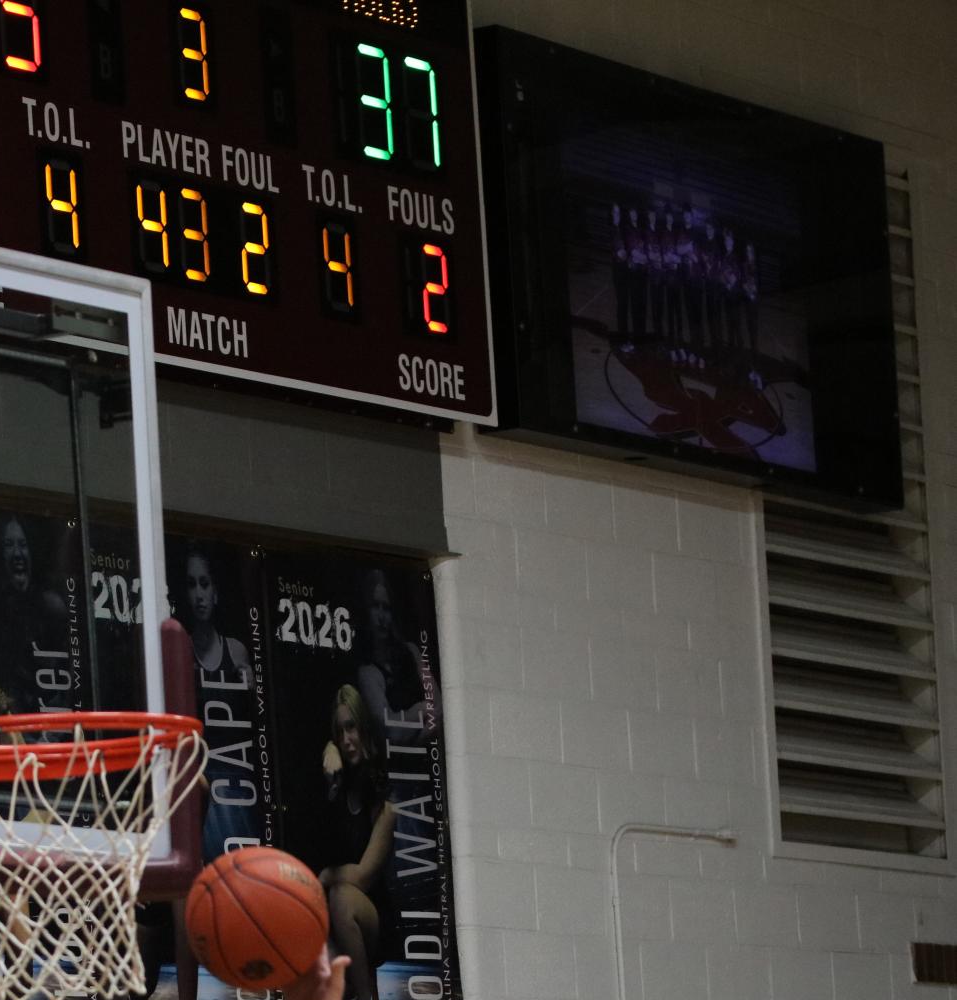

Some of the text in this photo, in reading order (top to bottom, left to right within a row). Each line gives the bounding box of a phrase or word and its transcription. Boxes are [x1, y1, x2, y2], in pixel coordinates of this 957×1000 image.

[178, 6, 210, 102] 3
[21, 96, 91, 150] T.O.L.
[357, 42, 442, 169] 37
[121, 120, 280, 194] PLAYER FOUL
[301, 163, 363, 215] T.O.L.
[45, 162, 81, 250] 4
[135, 182, 211, 283] 43
[387, 184, 455, 235] FOULS
[240, 201, 270, 295] 2
[321, 226, 354, 308] 4
[421, 242, 450, 334] 2
[167, 305, 249, 359] MATCH
[397, 353, 467, 402] SCORE
[90, 551, 131, 571] Senior
[91, 570, 144, 625] 202
[277, 576, 315, 599] Senior
[66, 576, 82, 690] WRESTLING
[249, 606, 265, 715] WRESTLING
[275, 597, 355, 652] 2026
[420, 630, 437, 731] WRESTLING
[200, 669, 257, 807] CAPE
[257, 724, 272, 804] SCHOOL
[430, 738, 443, 812] SCHOOL
[265, 813, 273, 848] IGH
[384, 707, 439, 879] WAITE
[437, 819, 446, 865] HIGH
[440, 873, 450, 949] CENTRAL
